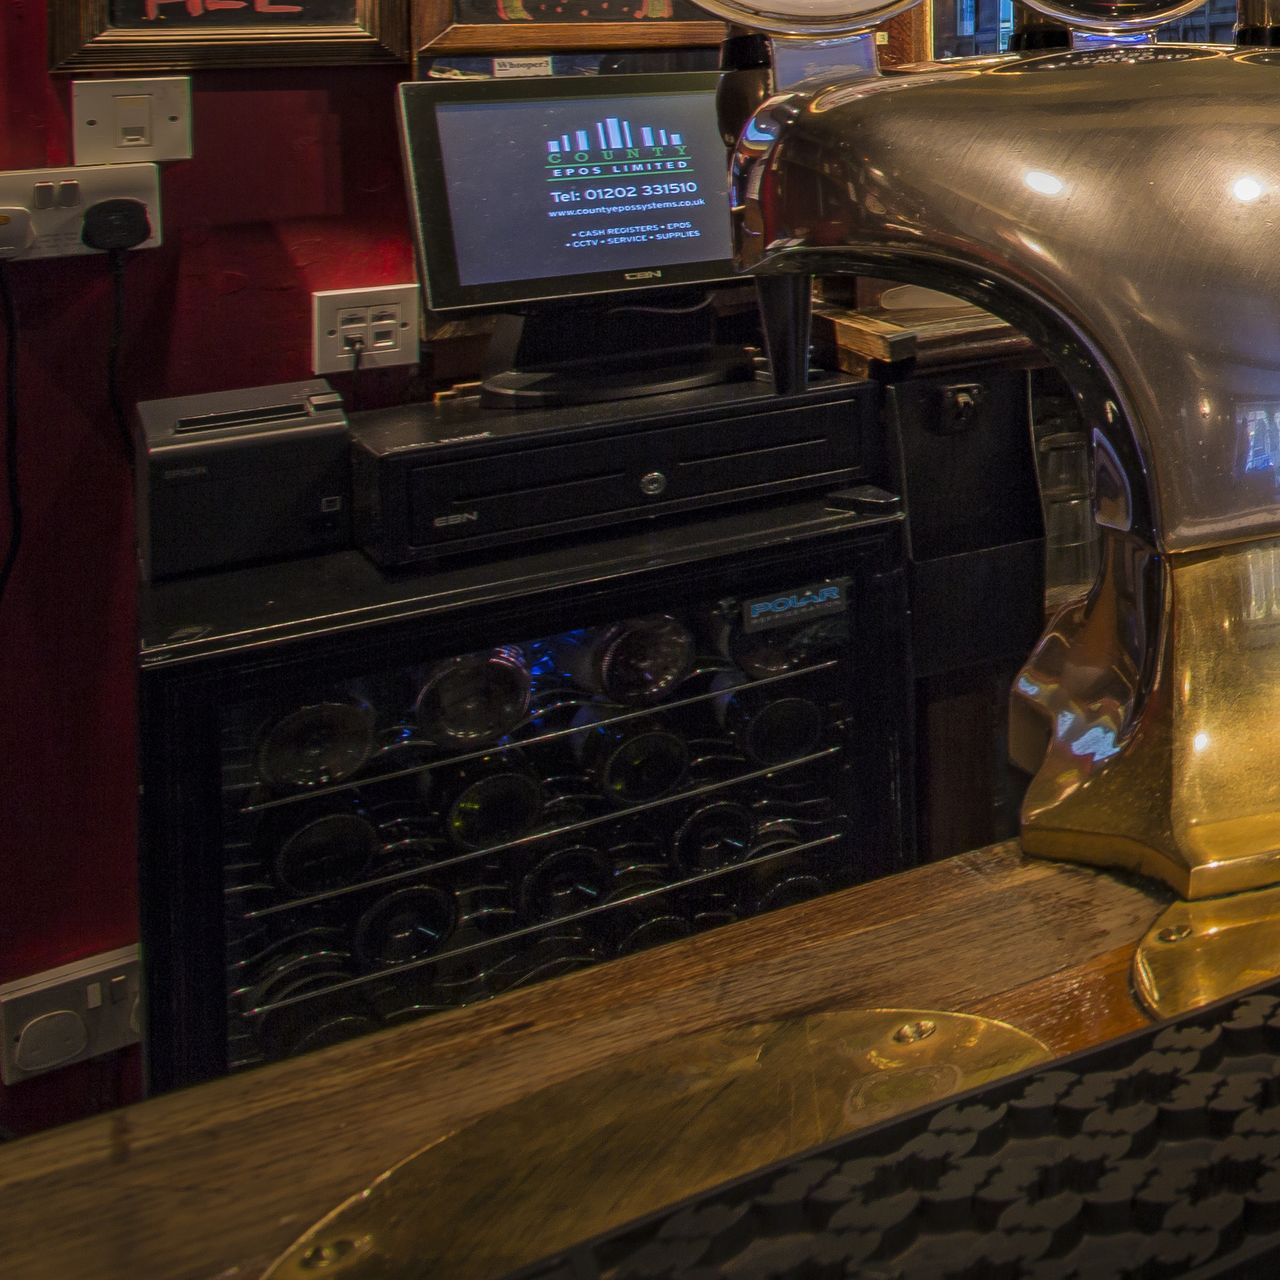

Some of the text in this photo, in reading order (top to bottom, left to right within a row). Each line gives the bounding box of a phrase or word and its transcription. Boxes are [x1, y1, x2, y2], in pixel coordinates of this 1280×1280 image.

[548, 146, 687, 164] COUNTY
[553, 162, 687, 177] EPOS LIMITED
[551, 182, 697, 203] Tel: 01202 331510
[548, 198, 705, 217] www.countyepossystems.co.uk
